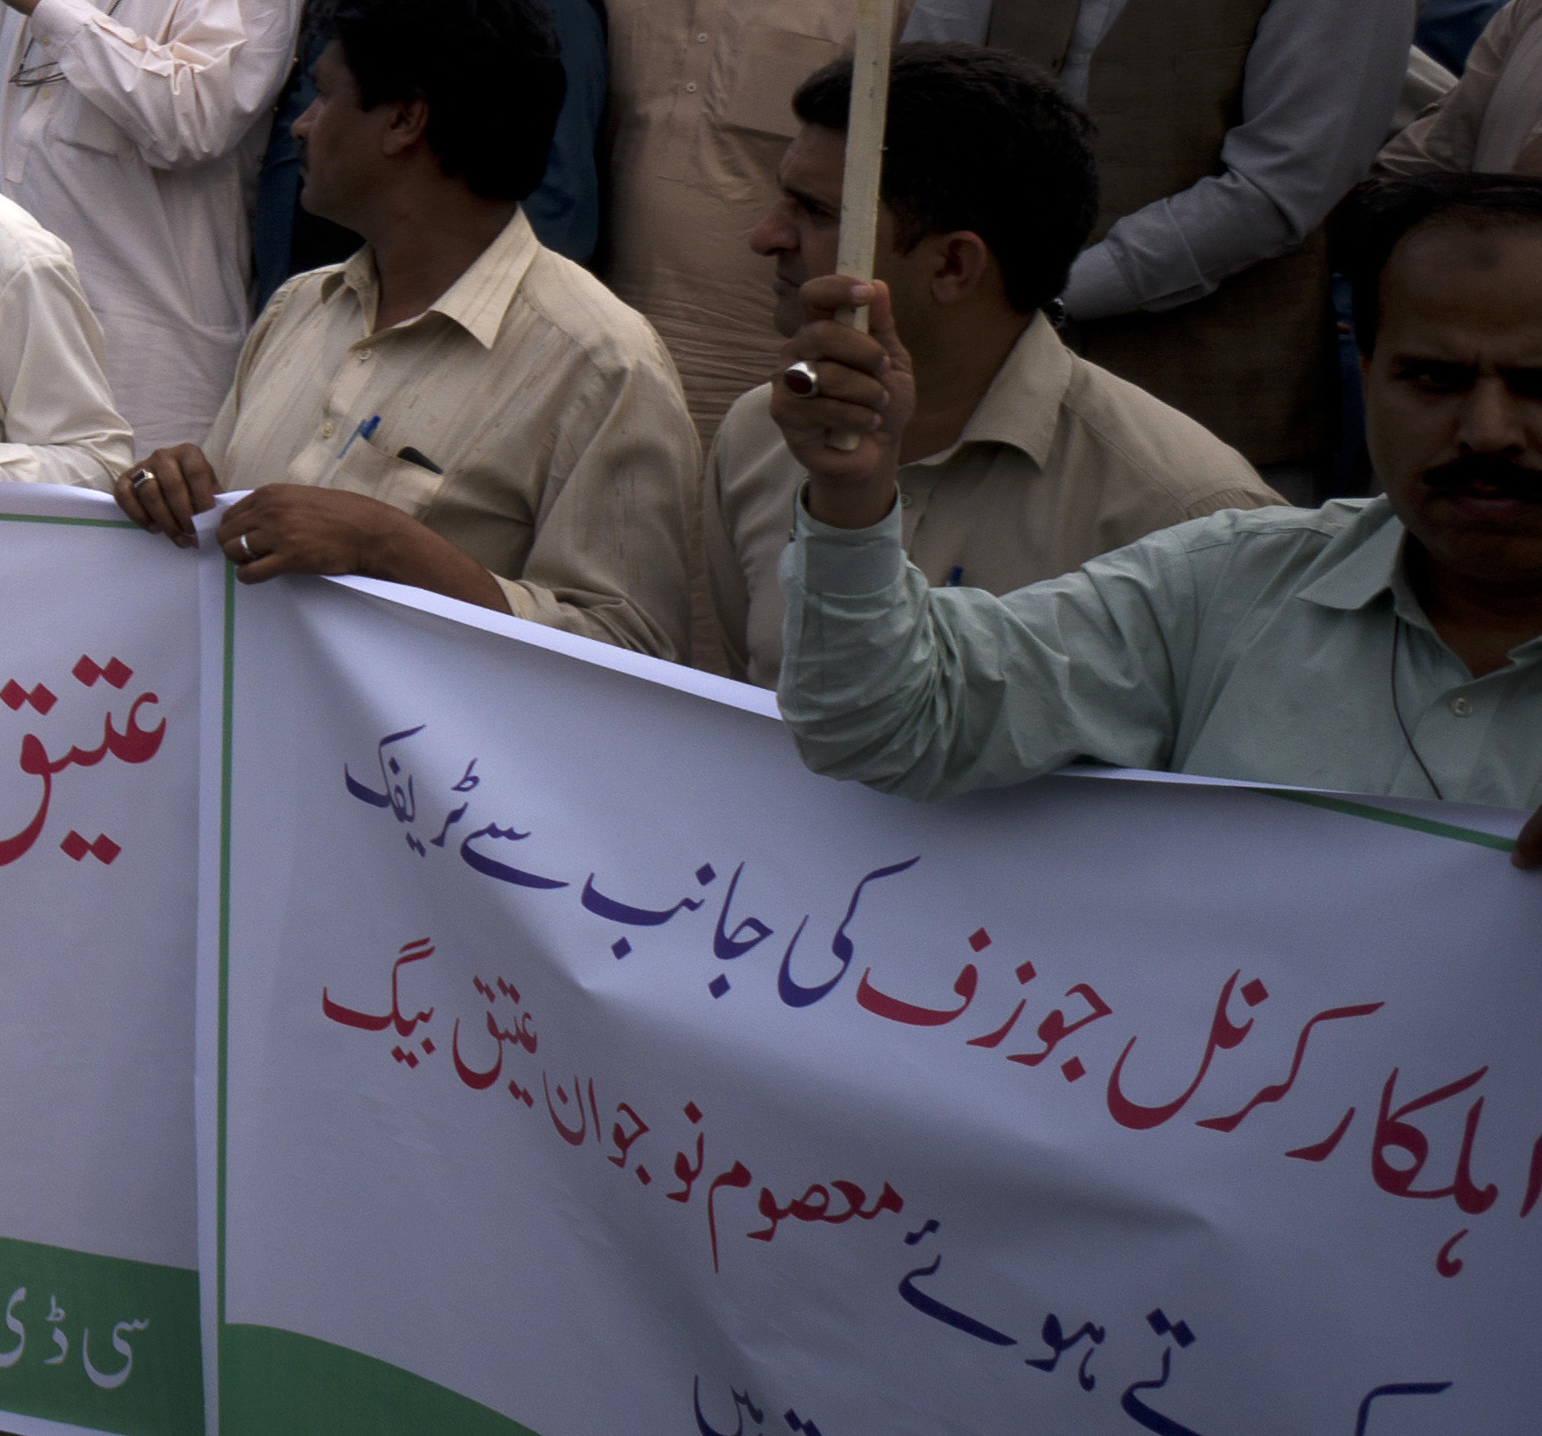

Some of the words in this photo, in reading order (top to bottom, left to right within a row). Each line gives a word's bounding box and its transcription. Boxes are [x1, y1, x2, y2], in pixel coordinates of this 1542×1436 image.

[459, 822, 570, 890] سے
[580, 862, 774, 1000] جانب
[777, 855, 921, 1009] کی
[322, 937, 436, 1069] بیگ
[452, 975, 538, 1109] عتیق
[856, 927, 1113, 1083] جوزف
[1106, 969, 1386, 1133] کرنل
[707, 1160, 905, 1274] معصوم
[83, 1320, 148, 1389] سی
